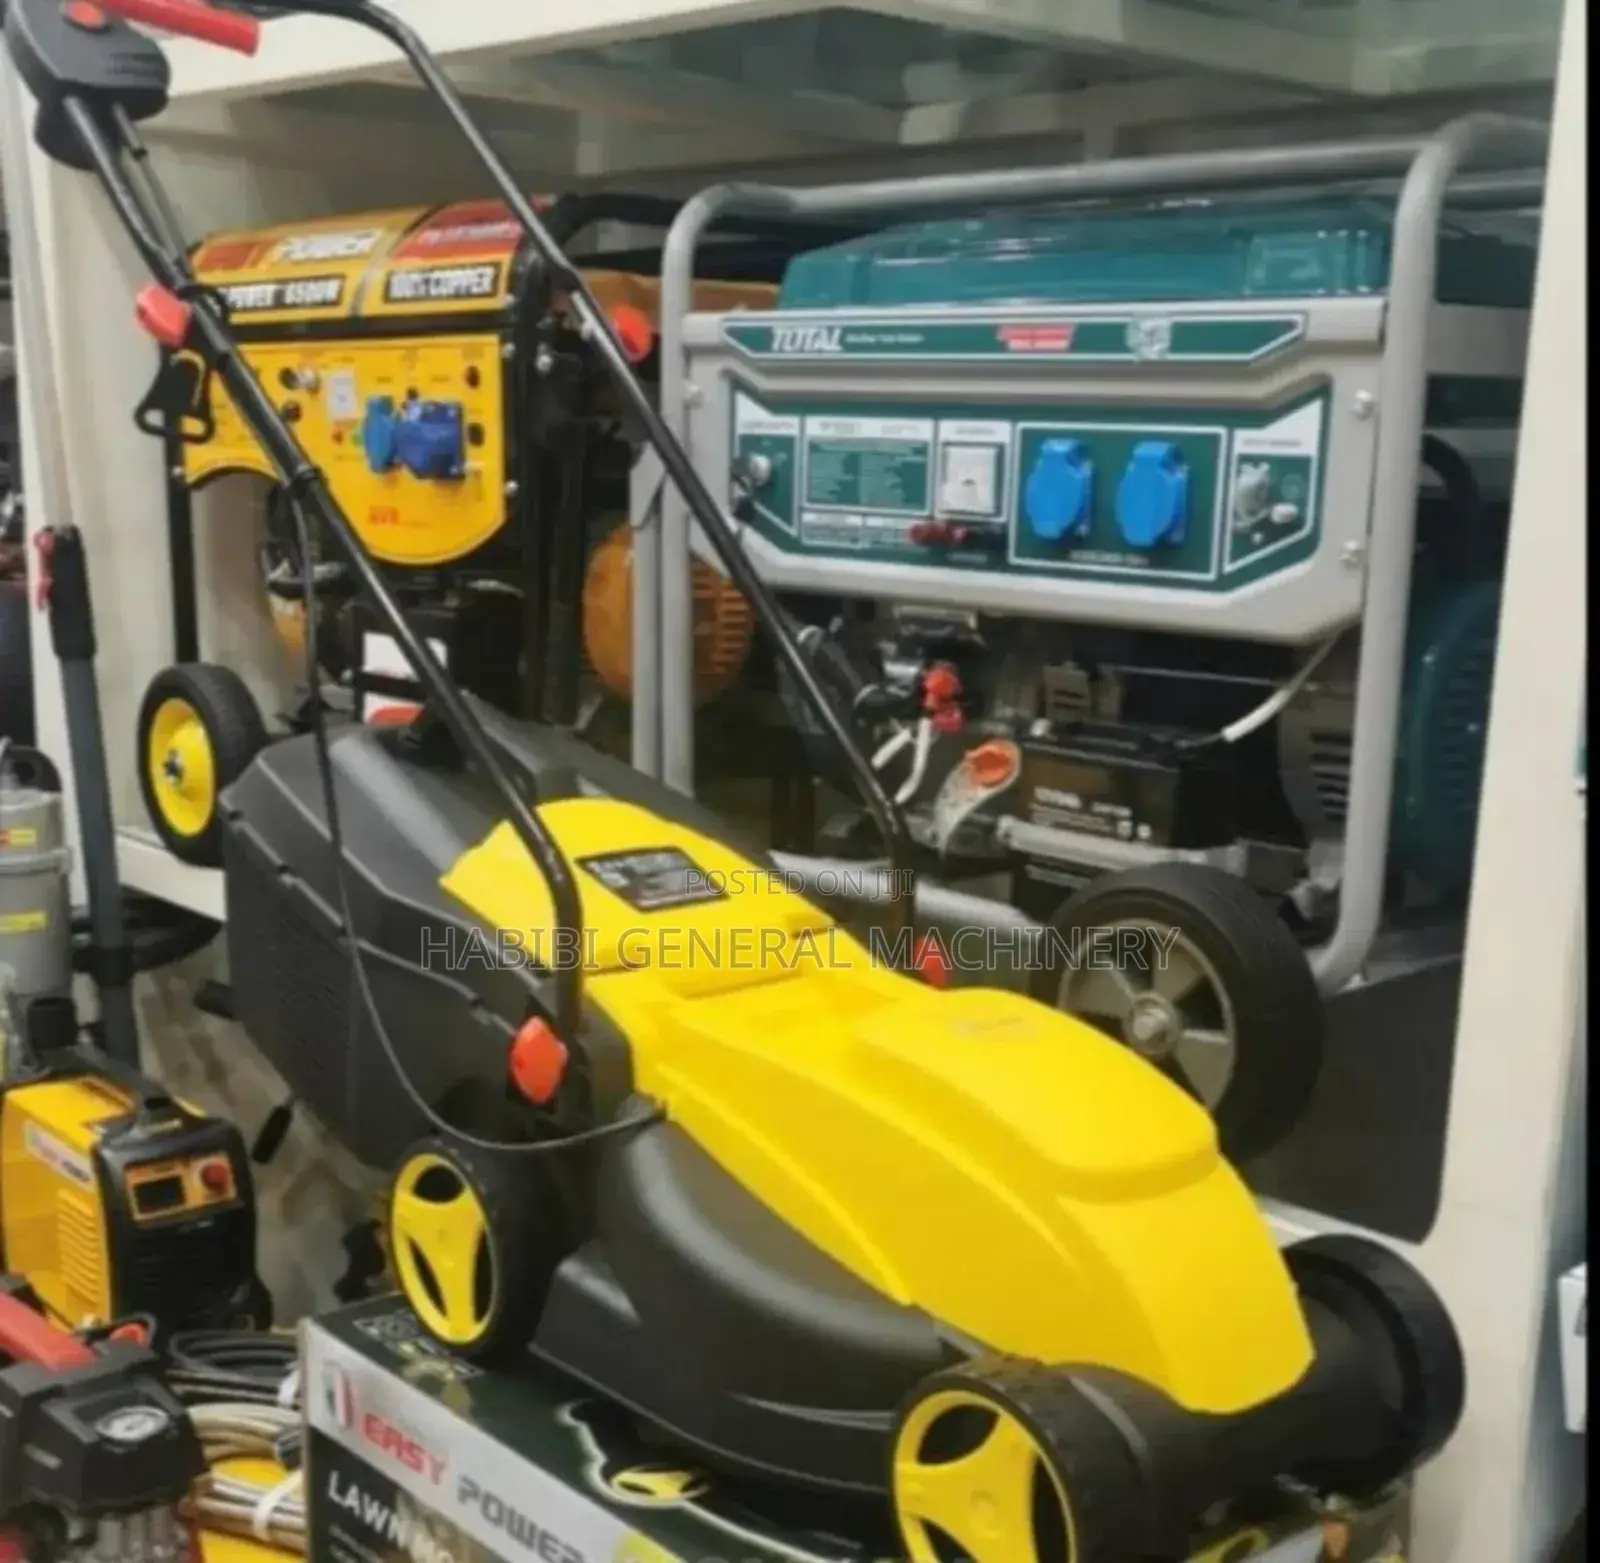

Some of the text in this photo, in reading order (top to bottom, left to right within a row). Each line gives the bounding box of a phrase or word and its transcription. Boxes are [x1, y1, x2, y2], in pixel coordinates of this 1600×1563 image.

[769, 326, 844, 352] TOTAL
[362, 1411, 447, 1486] EASY
[327, 1470, 410, 1548] LAWN
